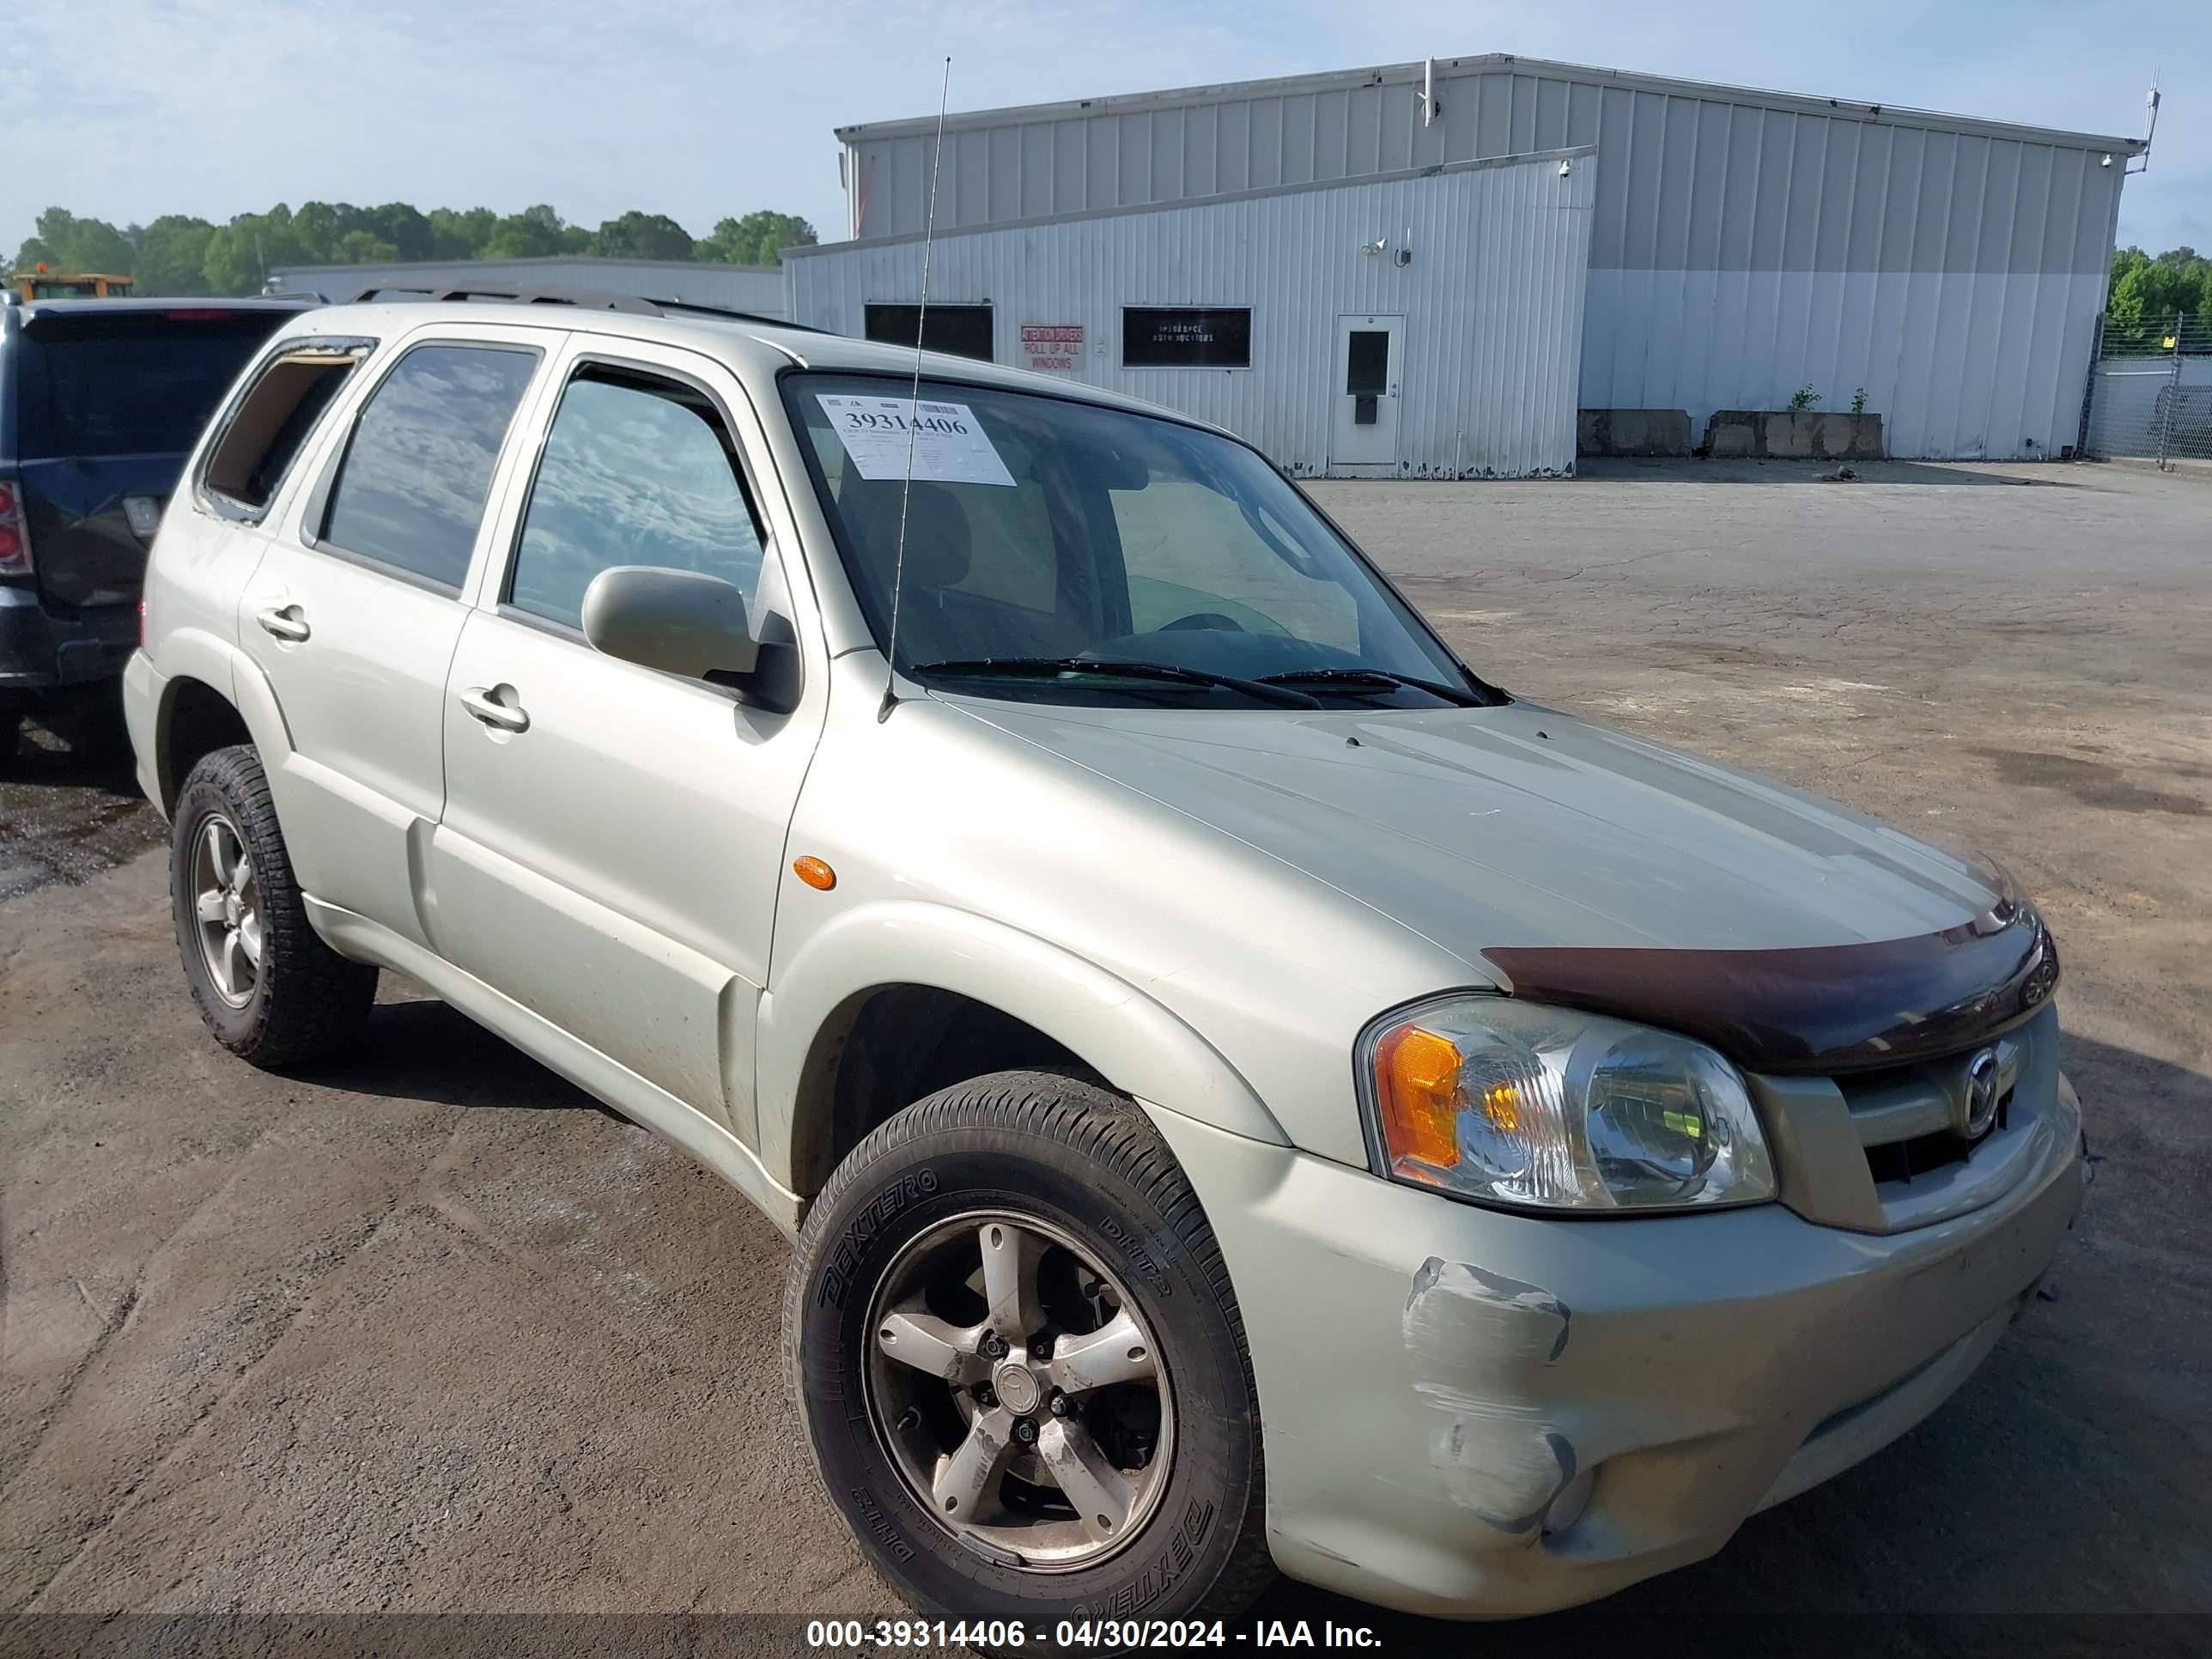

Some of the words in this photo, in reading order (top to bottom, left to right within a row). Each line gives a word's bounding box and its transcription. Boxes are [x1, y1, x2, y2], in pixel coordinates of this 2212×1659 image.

[1024, 343, 1046, 355] ROLL
[1050, 343, 1061, 355] UP
[1064, 343, 1079, 355] ALL
[1032, 357, 1072, 369] WINDOWS
[845, 413, 969, 435] 39314406
[817, 1167, 939, 1310] DEXTERO
[1098, 1216, 1173, 1297] DHT2
[851, 1486, 917, 1564] DHT2
